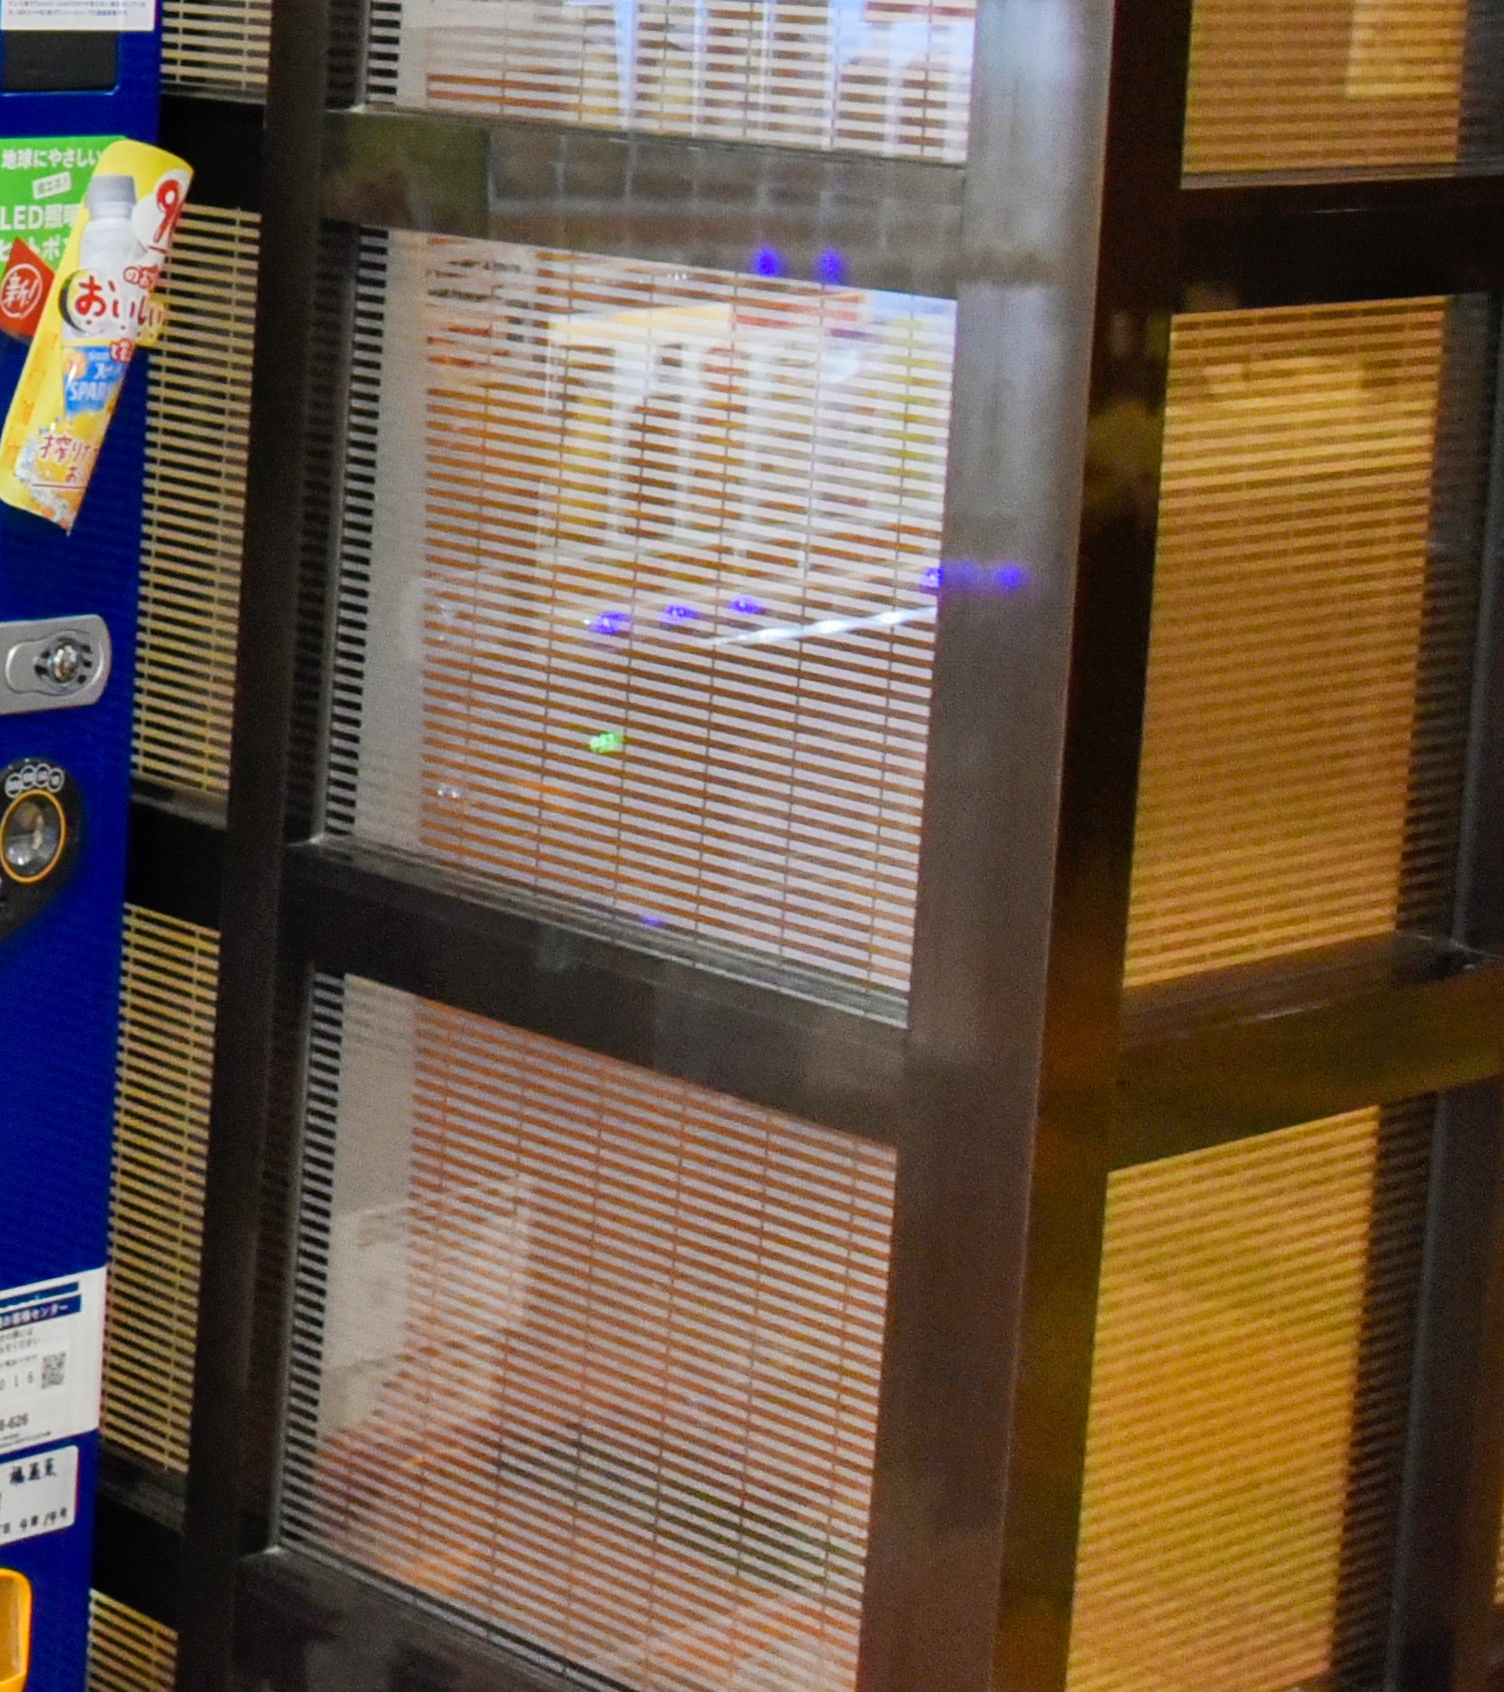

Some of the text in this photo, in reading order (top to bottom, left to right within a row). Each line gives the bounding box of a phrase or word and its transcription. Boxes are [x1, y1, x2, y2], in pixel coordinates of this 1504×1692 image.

[1, 149, 101, 169] 地球にやさしい
